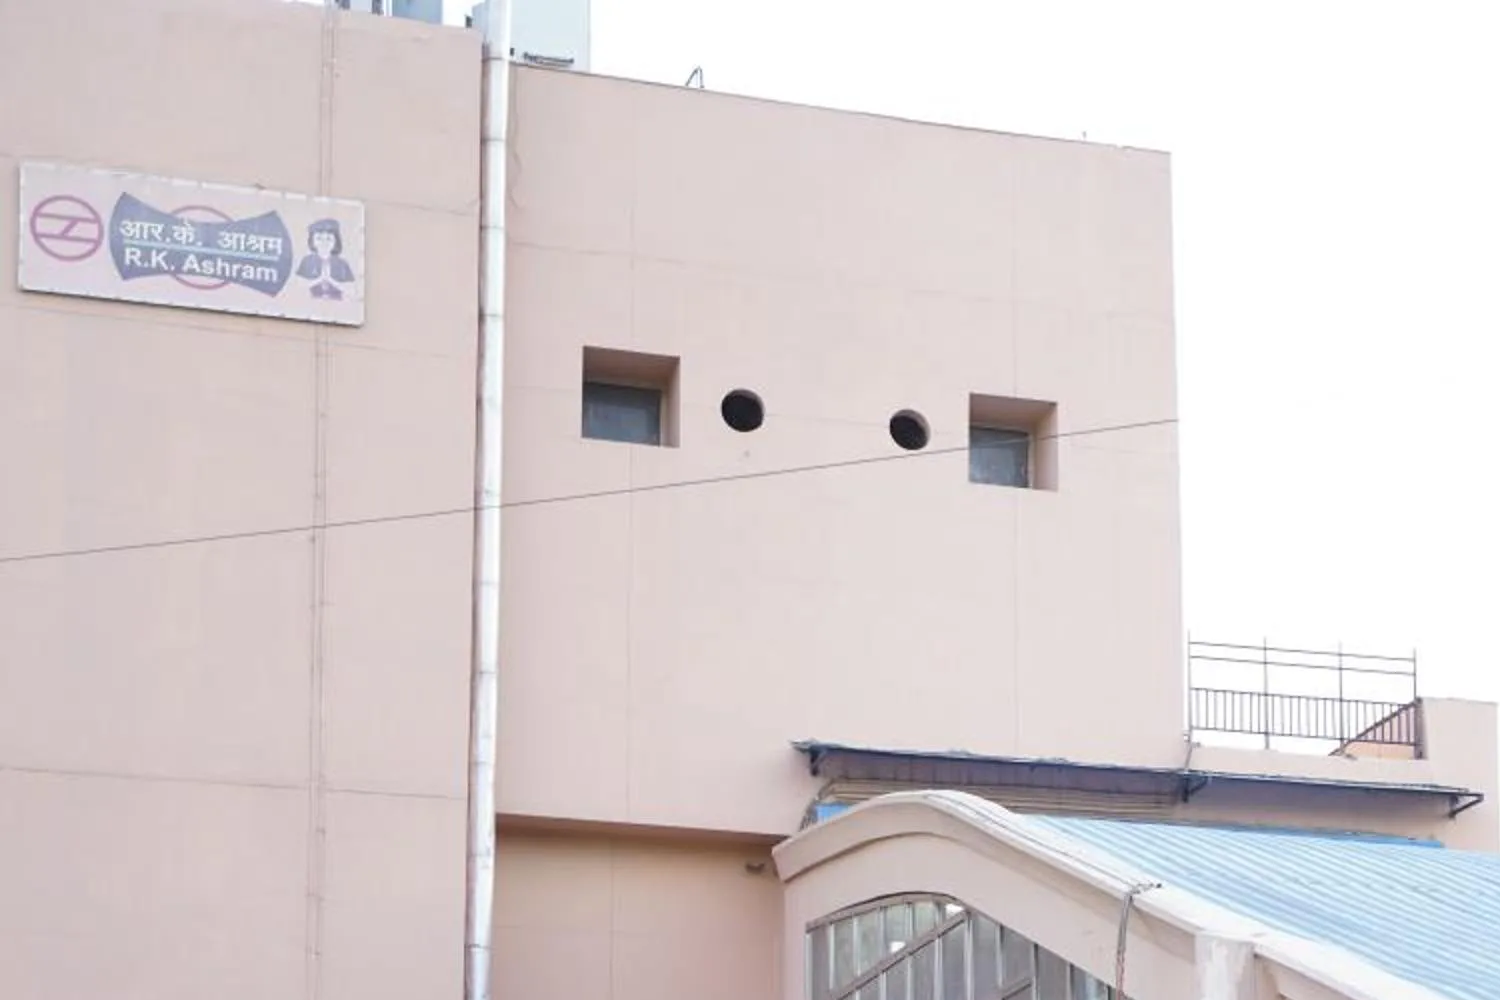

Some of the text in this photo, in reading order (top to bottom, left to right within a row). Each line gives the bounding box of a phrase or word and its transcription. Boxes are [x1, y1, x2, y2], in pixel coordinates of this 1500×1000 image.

[217, 230, 283, 255] आश्रम
[124, 247, 278, 283] R.K. Ashram
